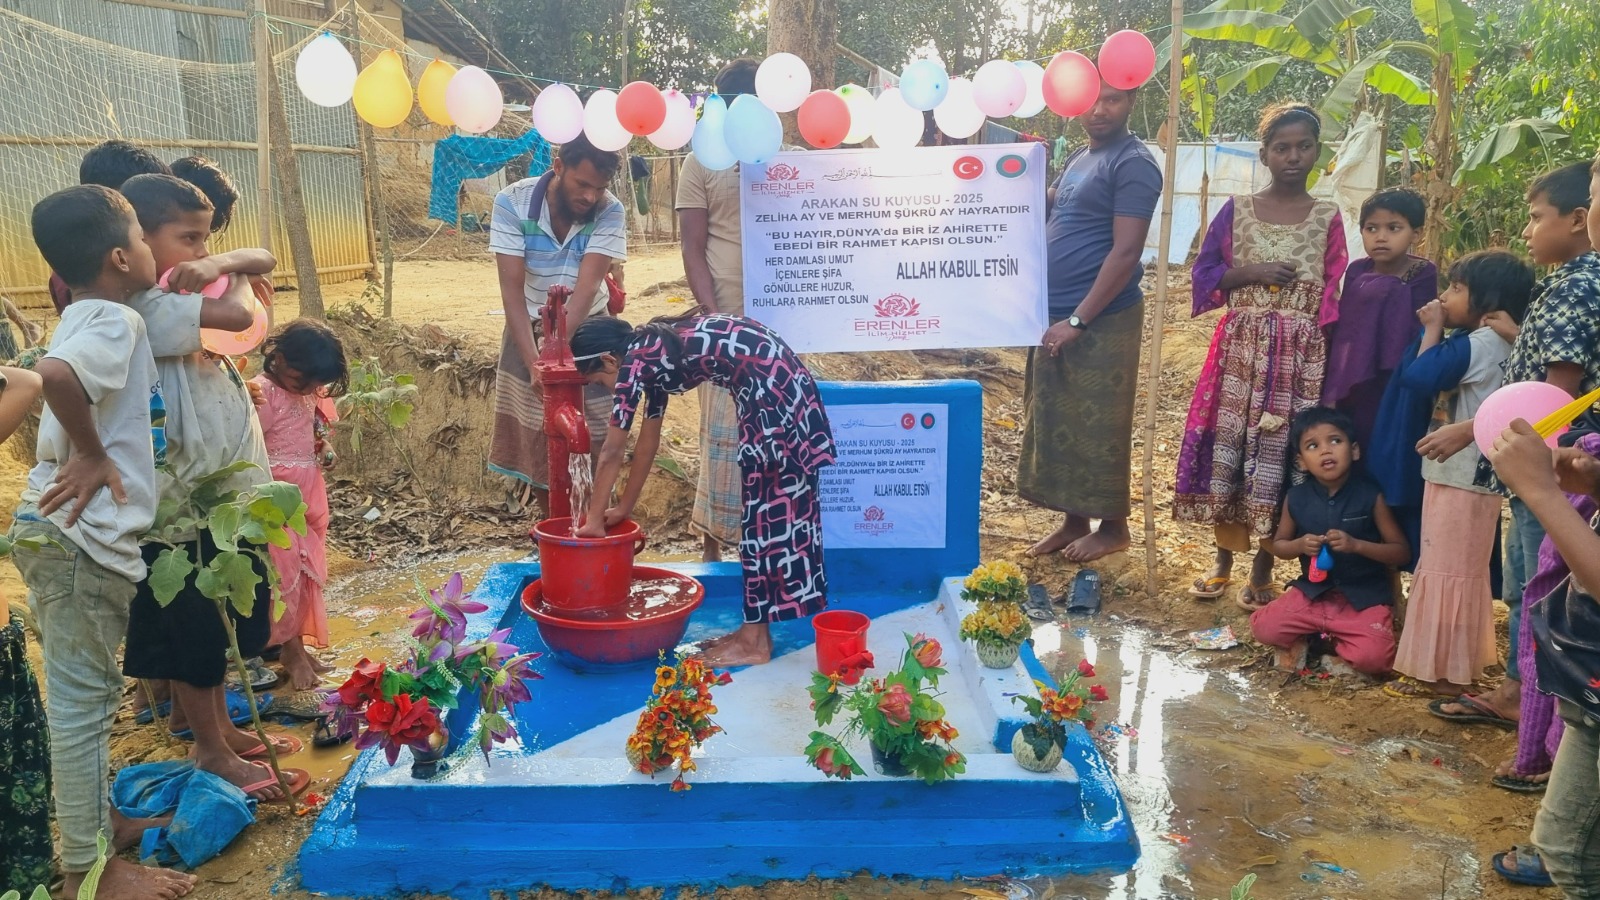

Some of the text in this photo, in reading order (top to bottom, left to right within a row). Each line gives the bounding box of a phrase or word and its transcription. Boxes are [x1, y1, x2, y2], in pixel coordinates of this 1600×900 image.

[751, 182, 815, 191] ERENLER
[801, 198, 858, 210] ARAKAN
[862, 197, 880, 207] SU
[885, 195, 941, 206] KUYUSU
[953, 193, 983, 204] 2025
[755, 205, 1030, 222] ZELİHA AY VE MERHUM ŞÜKRÜ AY HAYRATIDIR
[902, 225, 925, 235] BİR
[928, 225, 940, 234] İZ
[943, 224, 1008, 233] AHİRETTE
[774, 241, 813, 251] EBEDİ
[817, 240, 838, 249] BİR
[842, 239, 897, 249] RAHMET
[901, 237, 944, 247] KAPISI
[765, 254, 854, 266] HER DAMLASI UMUT
[896, 254, 1019, 280] ALLAH KABUL ETSİN
[775, 267, 842, 281] İÇENLERE ŞİFA
[763, 281, 855, 294] GÖNÜLLERE HUZUR,
[752, 294, 869, 307] RUHLARA RAHMET OLSUN
[854, 318, 940, 331] ERENLER
[836, 440, 857, 448] RAKAN
[859, 439, 868, 447] SU
[870, 439, 896, 447] KUYUSU
[901, 438, 915, 447] 2025
[874, 481, 930, 497] ALLAH KABUL ETSİN
[854, 522, 894, 530] ERENLER
